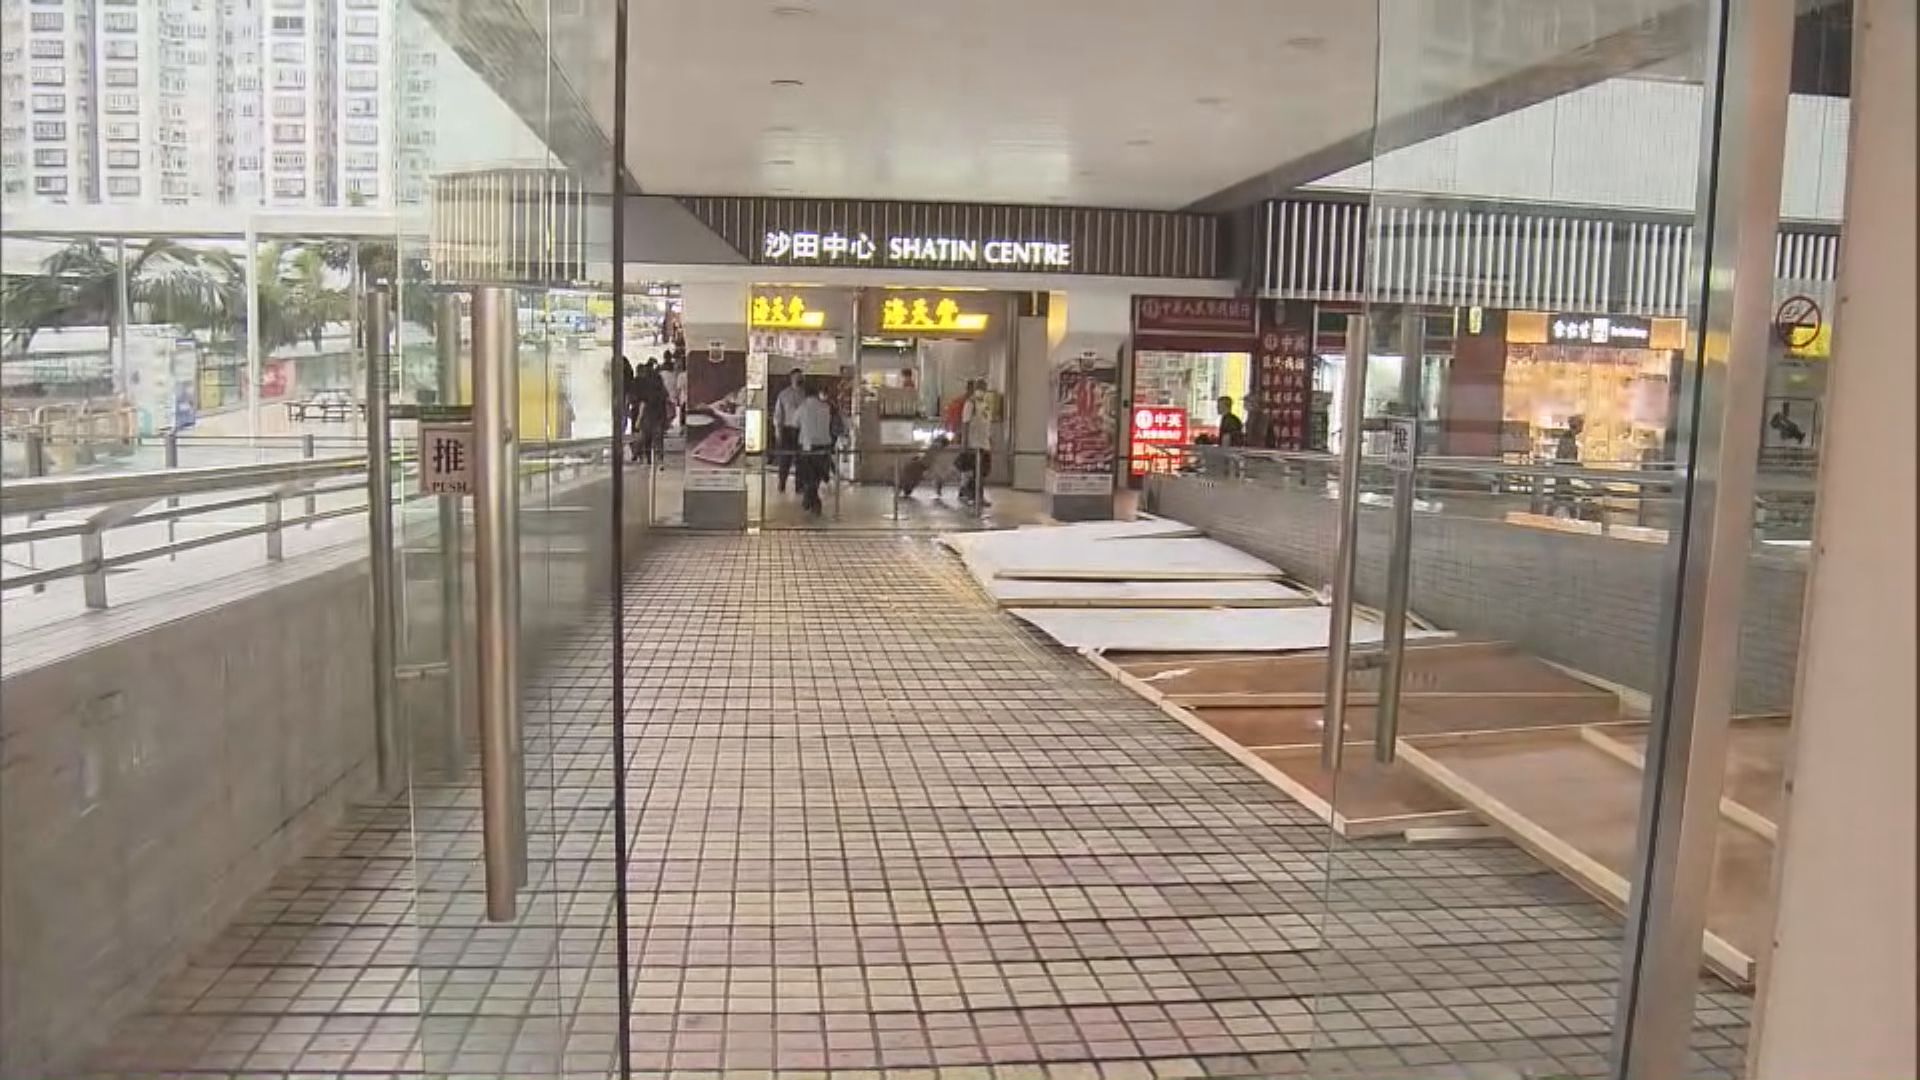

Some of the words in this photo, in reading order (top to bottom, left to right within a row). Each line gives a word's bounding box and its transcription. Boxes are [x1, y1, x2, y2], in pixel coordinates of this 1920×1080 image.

[765, 231, 876, 259] 沙田中心
[889, 236, 976, 262] SHATIN
[983, 241, 1071, 266] CENTRE
[752, 296, 804, 325] 海天堂
[883, 297, 959, 327] 海天堂
[1154, 412, 1182, 428] 中英
[432, 438, 465, 474] 推
[432, 481, 467, 493] PUSH
